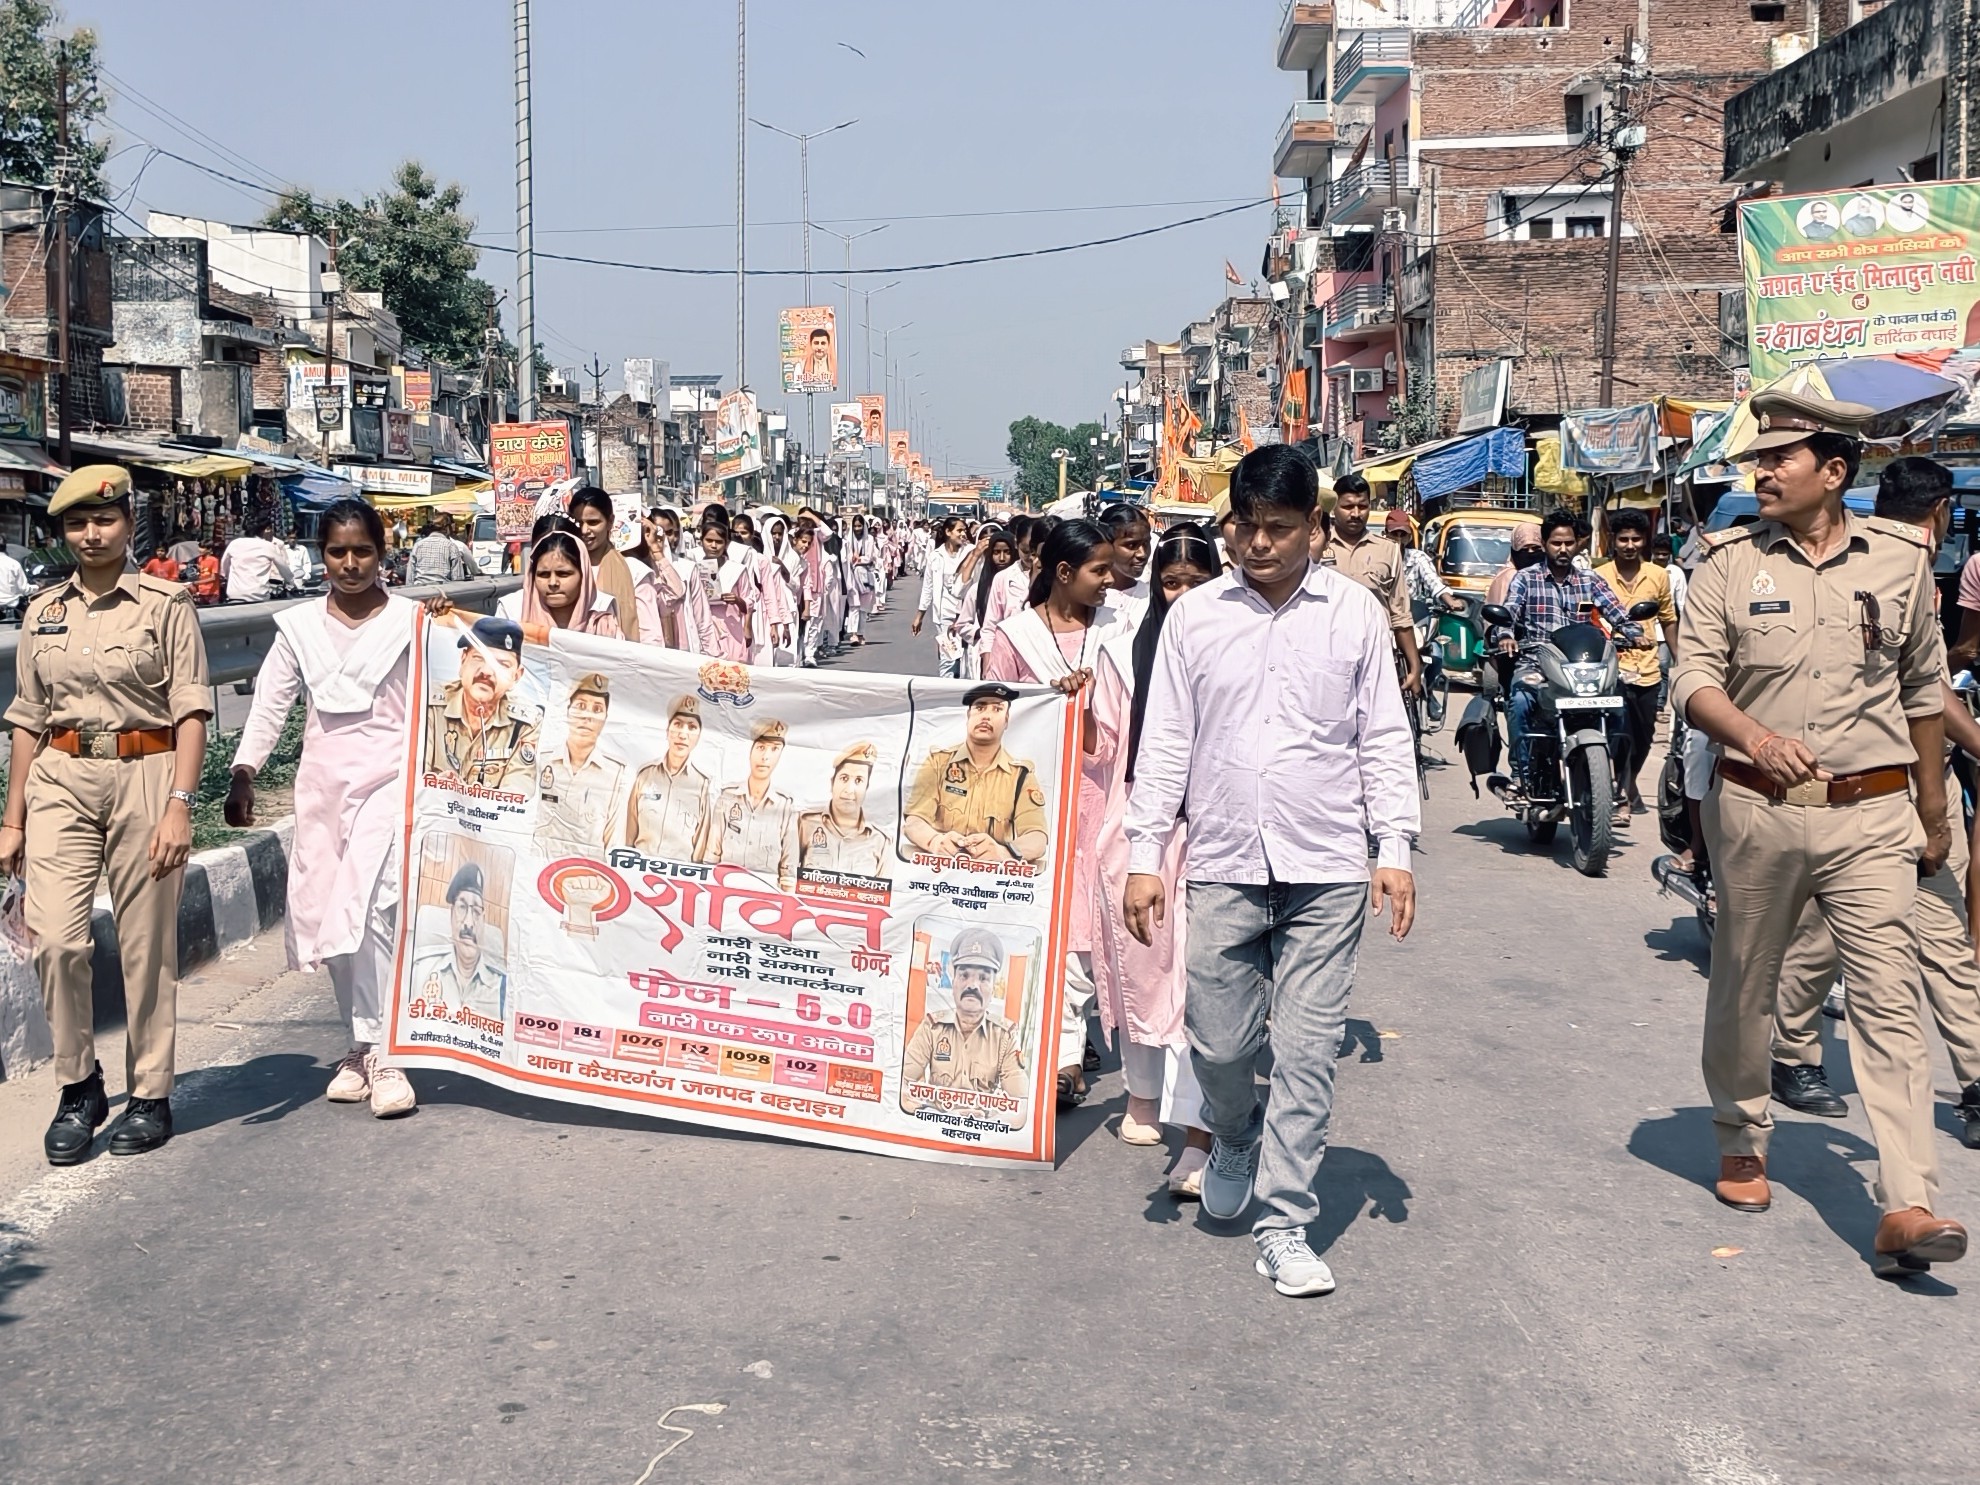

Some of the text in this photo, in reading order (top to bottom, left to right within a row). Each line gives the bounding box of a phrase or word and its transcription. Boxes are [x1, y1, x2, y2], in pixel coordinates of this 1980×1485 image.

[1781, 251, 1812, 262] आप
[1816, 245, 1848, 259] सभी
[1853, 243, 1879, 256] क्षेत्र
[1939, 236, 1962, 248] को
[1759, 255, 1975, 295] जशन-ए-ईद मिलादुन नबी
[1757, 311, 1866, 348] रक्षाबंधन
[1873, 308, 1957, 326] के पावन पर्व की
[1873, 328, 1918, 345] हार्दिक
[494, 437, 527, 453] चाय
[360, 469, 394, 481] AMUL
[398, 472, 429, 484] MILK
[423, 771, 527, 805] विश्वजीत श्रीवास्तव
[608, 848, 713, 881] मिशन
[956, 855, 998, 874] विक्रम
[1004, 860, 1036, 878] सिंह
[908, 880, 930, 892] अपर
[932, 881, 960, 896] पुलिस
[1002, 889, 1035, 905] (नगर)
[633, 862, 894, 954] शक्ति
[706, 935, 820, 960] नारी सुरक्षा
[706, 950, 836, 977] नारी सम्मान
[706, 965, 752, 979] नारी
[850, 944, 893, 978] केन्द्र
[627, 968, 737, 1010] फेज
[795, 993, 873, 1030] 5.0
[455, 1006, 505, 1037] श्रीवास्तव
[519, 1016, 560, 1032] 1090
[573, 1026, 602, 1039] 181
[647, 1009, 876, 1057] नारी एक रूप अनेक
[621, 1034, 664, 1049] 1076
[725, 1049, 771, 1065] 1098
[785, 1059, 818, 1073] 102
[526, 1054, 574, 1074] थाना
[578, 1059, 676, 1091] कैसरगंज
[680, 1079, 756, 1104] जनपद
[760, 1091, 847, 1119] बहराइच
[909, 1083, 1020, 1113] राज कुमार पाण्डेय
[963, 1114, 1010, 1134] कैसरगंज
